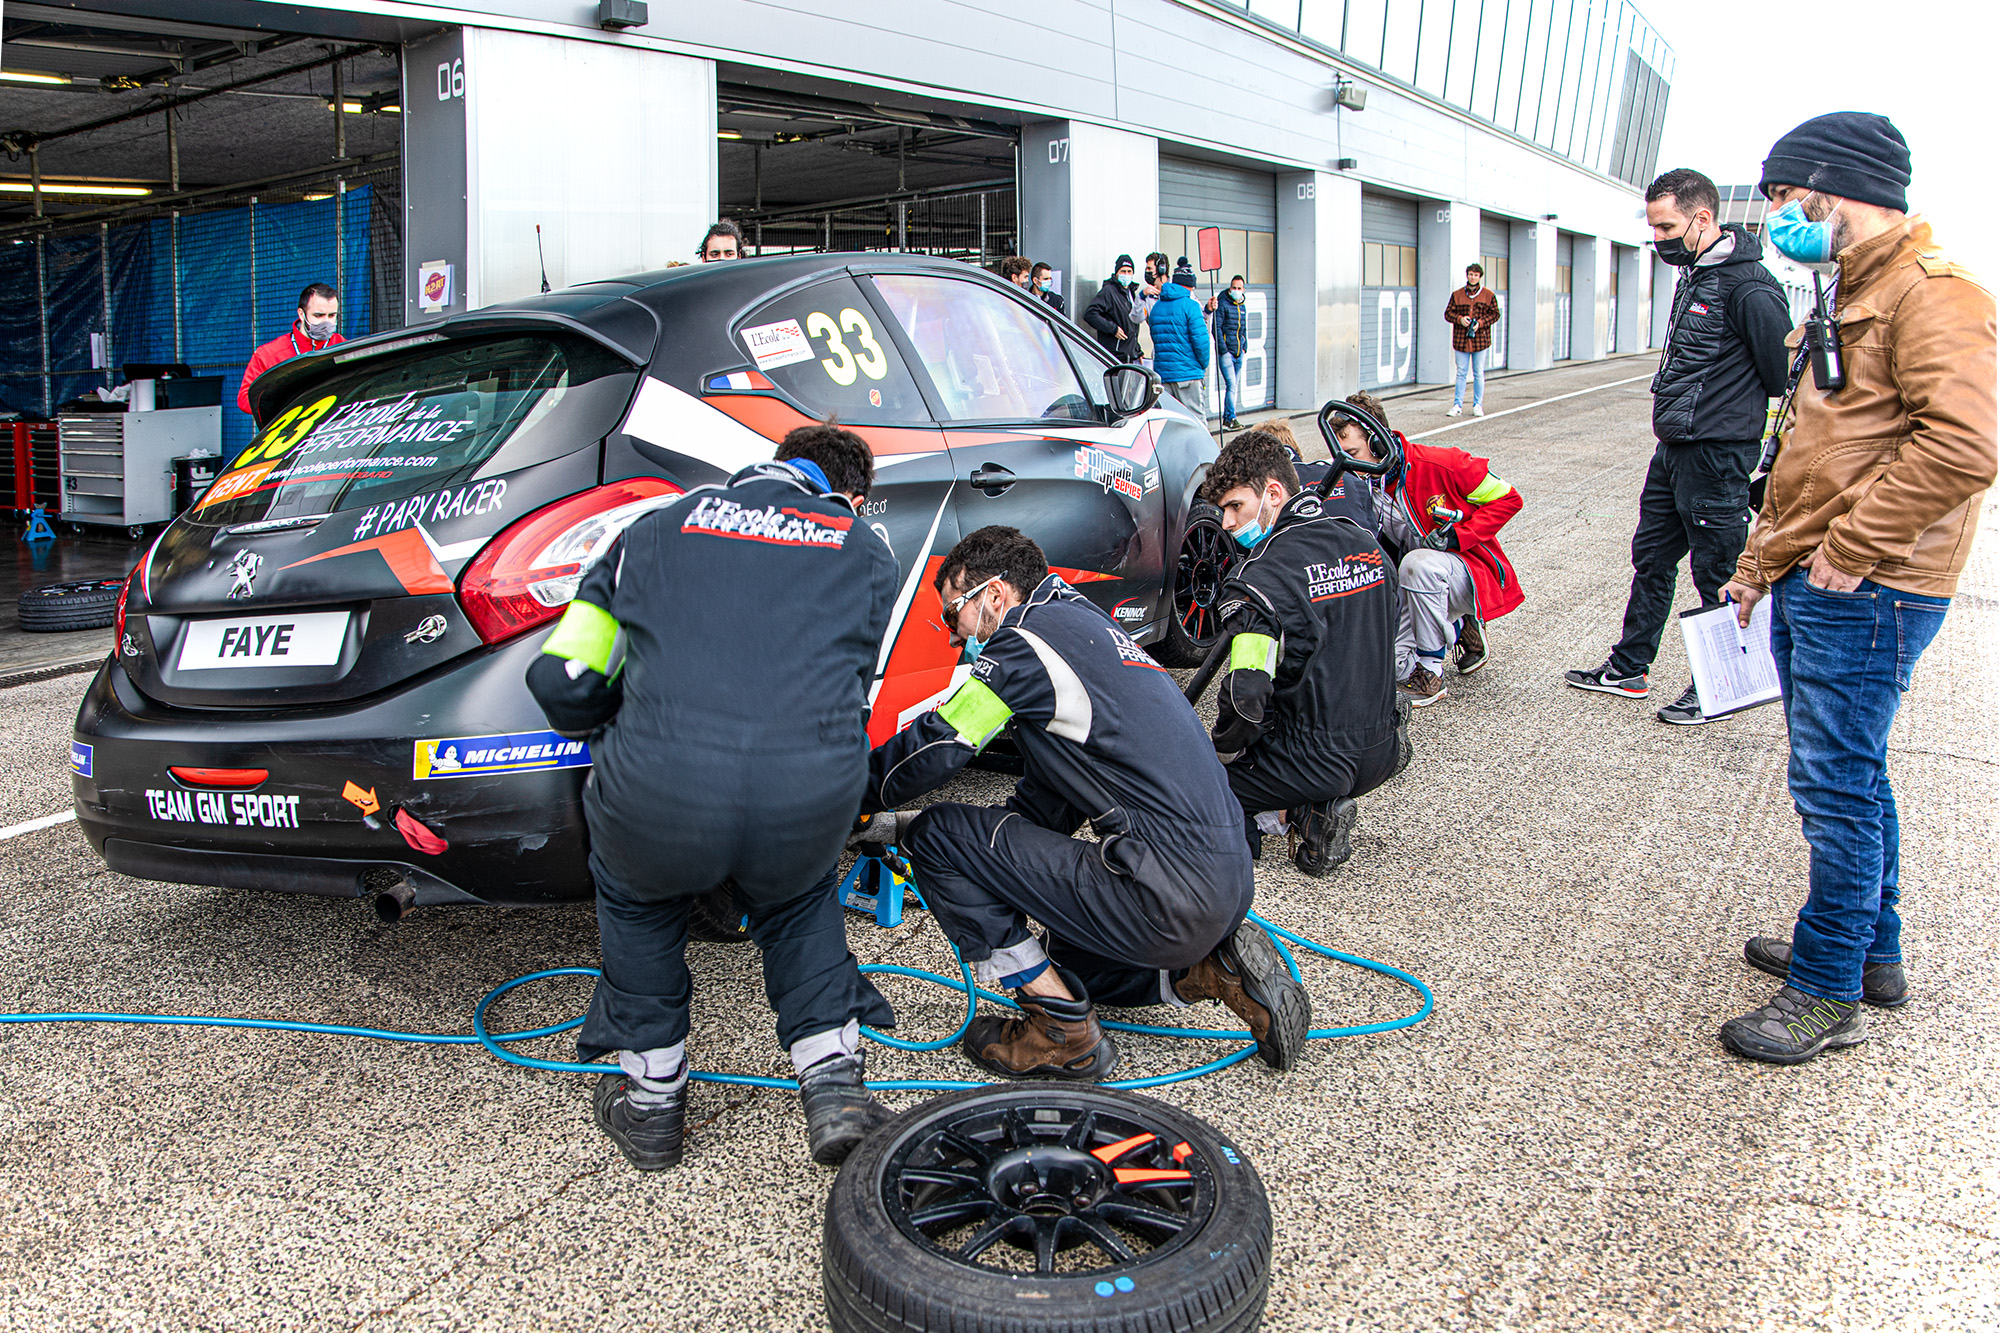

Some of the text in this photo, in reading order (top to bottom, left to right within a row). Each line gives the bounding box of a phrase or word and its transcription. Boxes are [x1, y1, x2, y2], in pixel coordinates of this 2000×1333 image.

[438, 57, 464, 101] 06
[1049, 138, 1069, 163] 07
[1297, 182, 1315, 200] 08
[1436, 209, 1450, 223] 09
[1528, 228, 1536, 239] 10
[1377, 291, 1412, 384] 09
[1608, 298, 1616, 351] 2
[806, 307, 888, 387] 33
[309, 390, 443, 436] L'Ecole de la
[234, 395, 337, 469] 33
[284, 420, 474, 460] PERFORMANCE
[431, 479, 507, 522] RACER
[1304, 558, 1350, 584] L'Ecole
[1308, 566, 1384, 598] PERFORMANCE
[1113, 606, 1147, 618] KENNOL
[218, 624, 295, 658] FAYE
[464, 741, 584, 764] MICHELIN
[144, 789, 300, 829] TEAM GM SPORT
